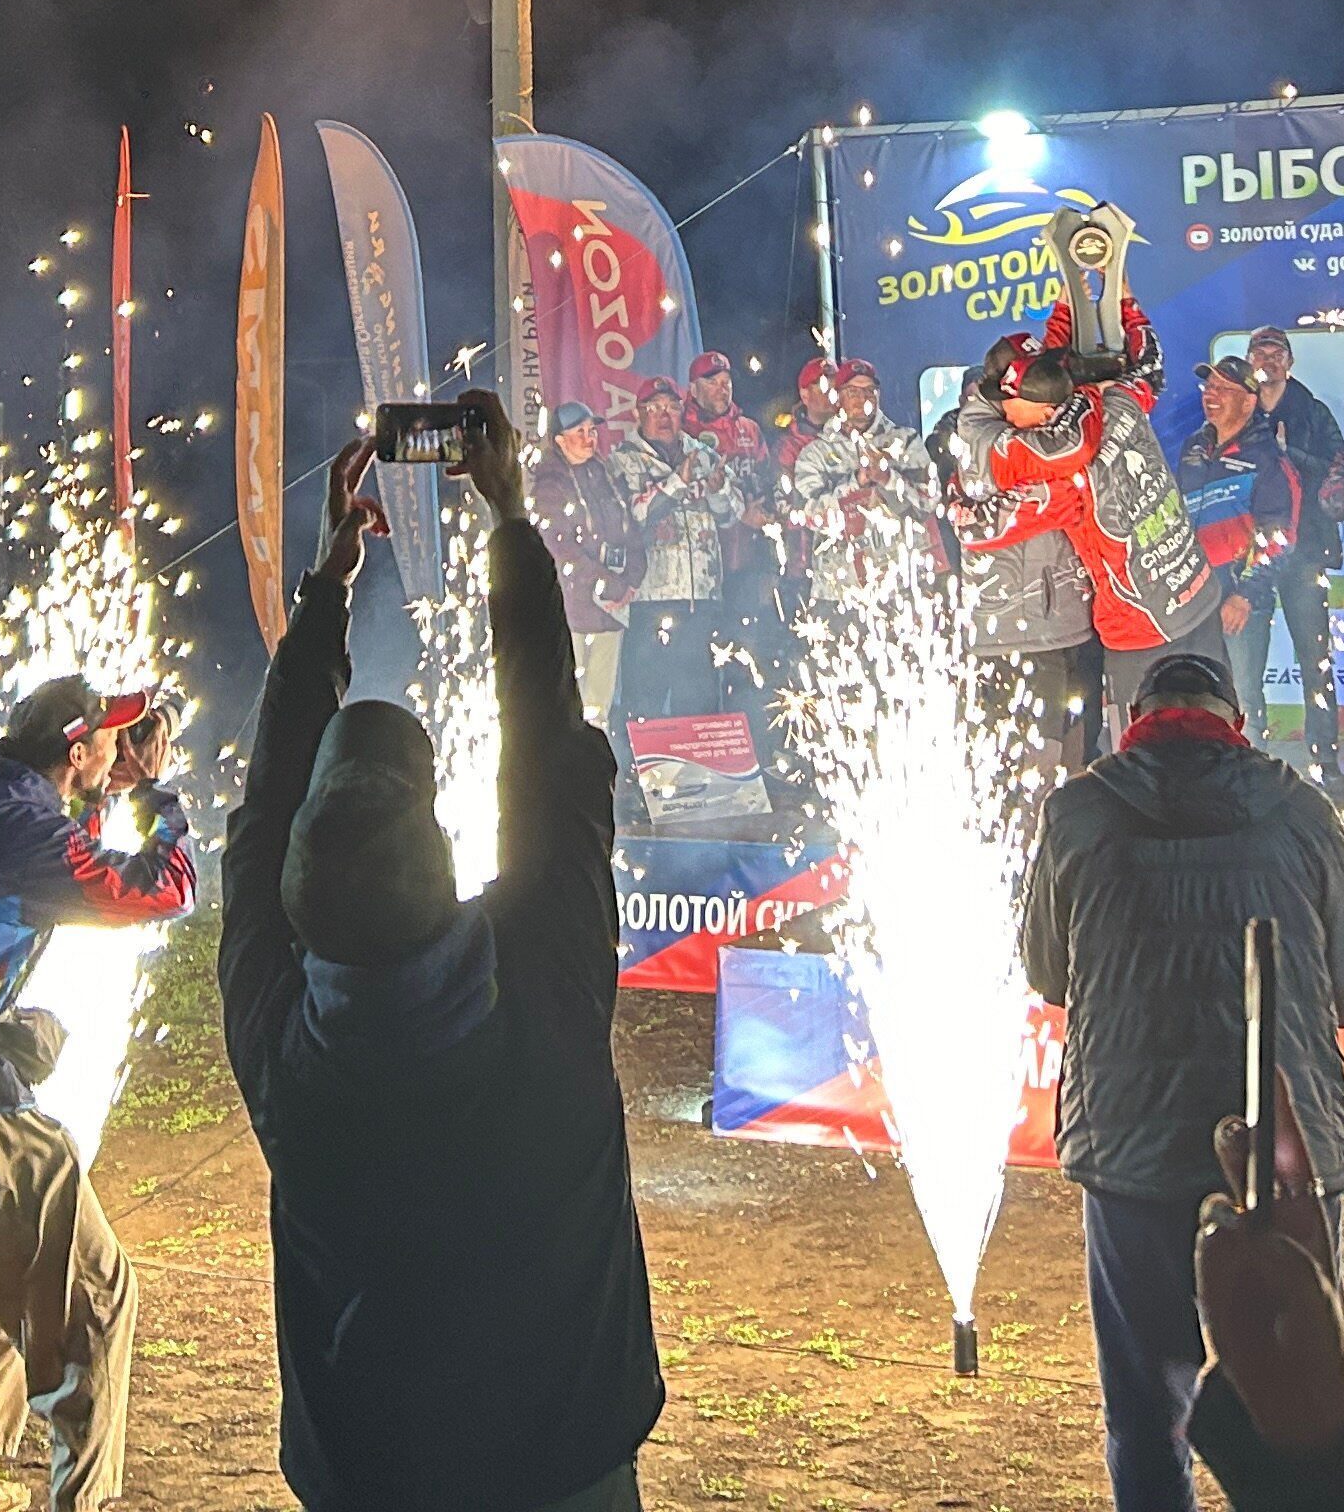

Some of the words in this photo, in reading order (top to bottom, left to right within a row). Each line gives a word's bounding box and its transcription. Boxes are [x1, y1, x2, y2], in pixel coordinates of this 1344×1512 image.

[1219, 220, 1297, 244] золотой
[877, 237, 1059, 306] ЗОЛОТОЙ
[966, 277, 1063, 321] СУДА
[617, 891, 748, 936] ЗОЛОТОЙ
